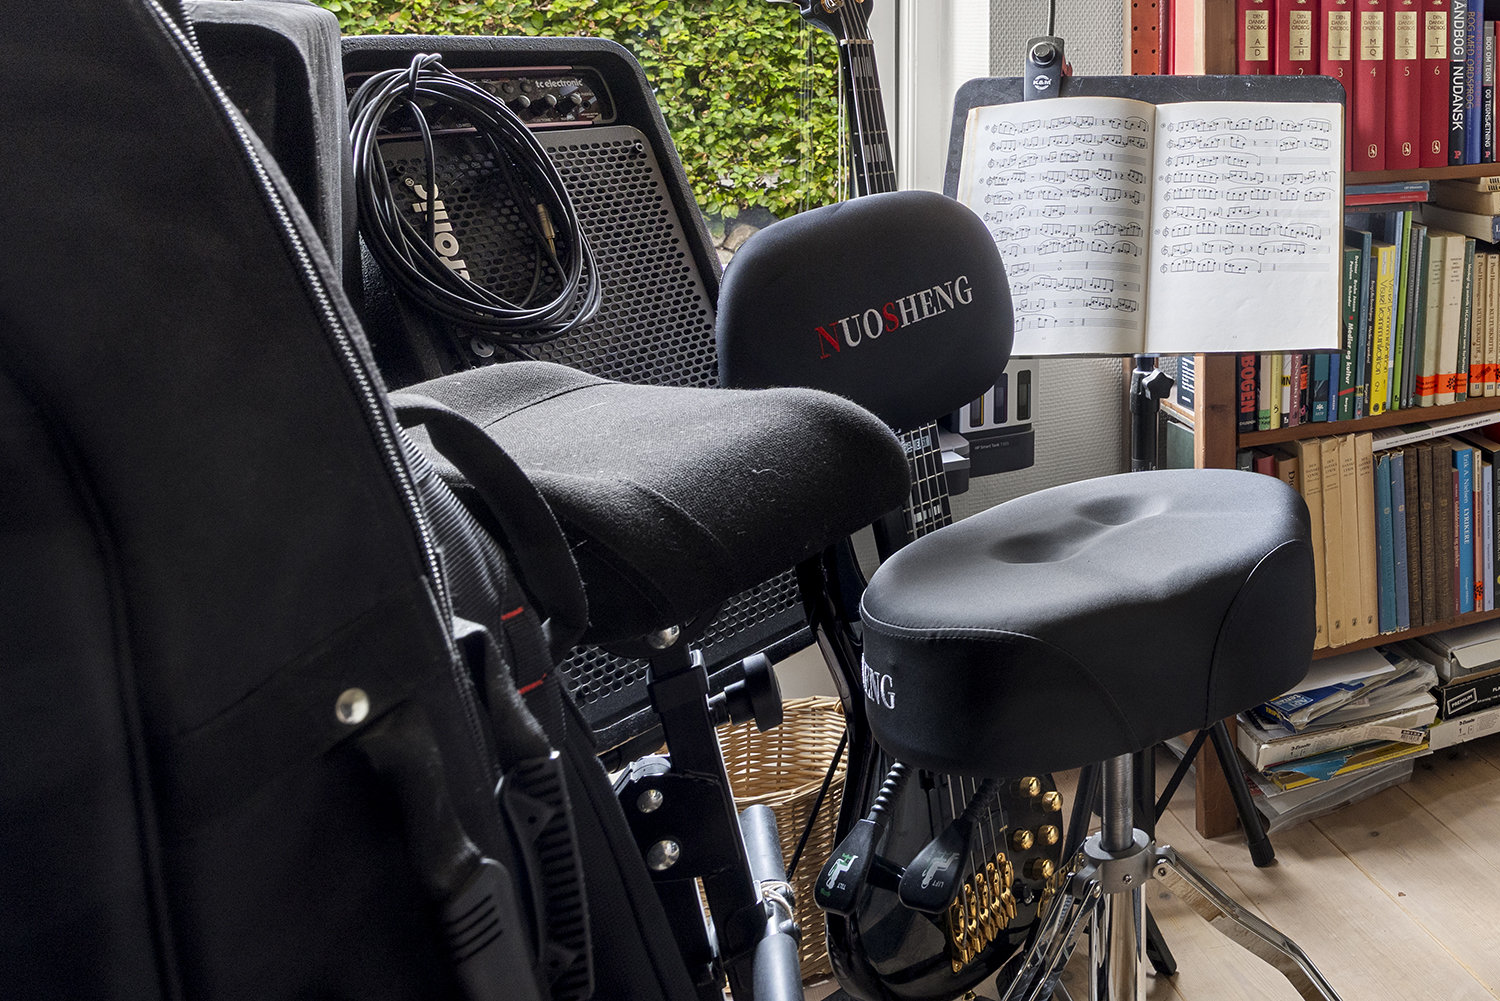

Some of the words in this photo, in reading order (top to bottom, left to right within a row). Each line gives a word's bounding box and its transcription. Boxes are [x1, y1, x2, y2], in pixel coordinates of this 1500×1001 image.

[1467, 12, 1475, 31] BOG
[1486, 52, 1491, 62] OM
[535, 80, 545, 88] tc
[545, 79, 583, 87] electronic
[1466, 59, 1474, 109] ORDSPROG
[1485, 90, 1491, 98] OG
[1452, 67, 1464, 131] NUDANSK
[815, 275, 973, 360] NUOSHENG
[1346, 323, 1354, 349] Medier
[1241, 355, 1255, 413] BOGEN
[1451, 694, 1473, 708] PREMIUM
